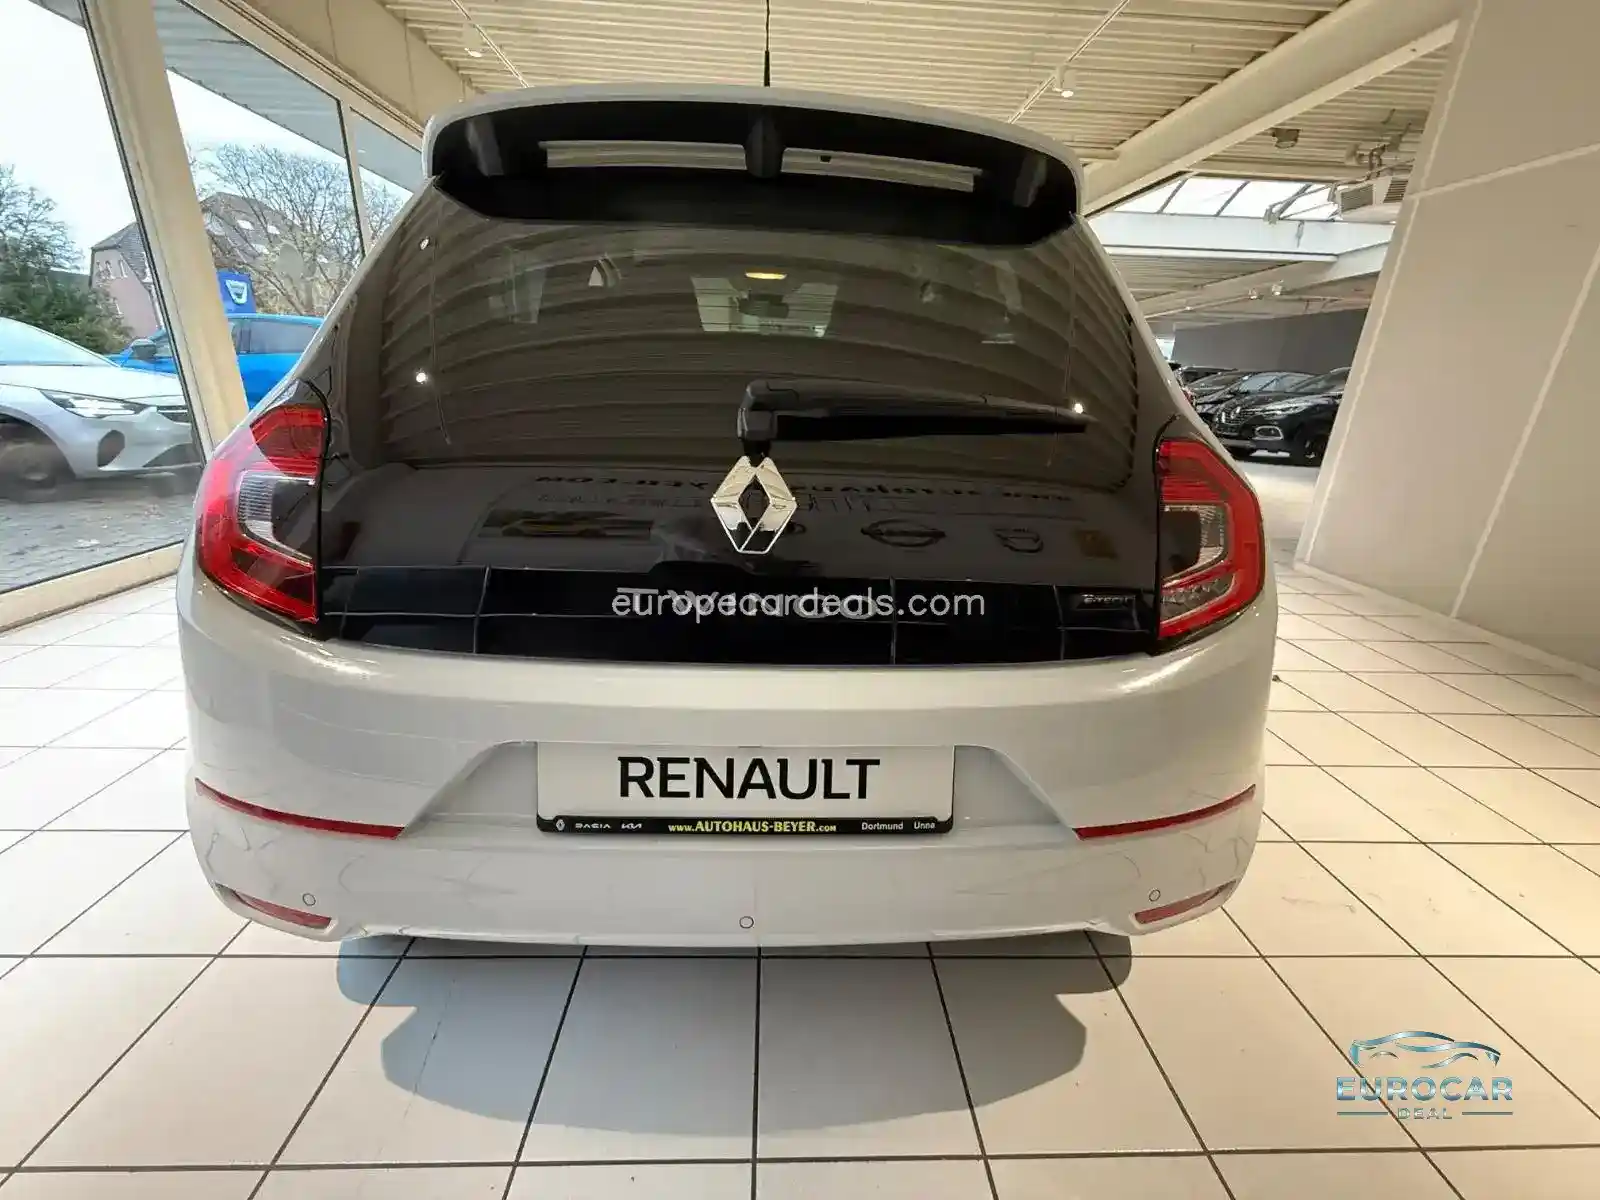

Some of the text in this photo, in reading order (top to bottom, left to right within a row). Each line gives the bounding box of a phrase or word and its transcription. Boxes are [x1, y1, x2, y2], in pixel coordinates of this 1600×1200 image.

[617, 757, 880, 799] RENAULT
[861, 822, 903, 830] Dortmund
[914, 821, 935, 829] Unna
